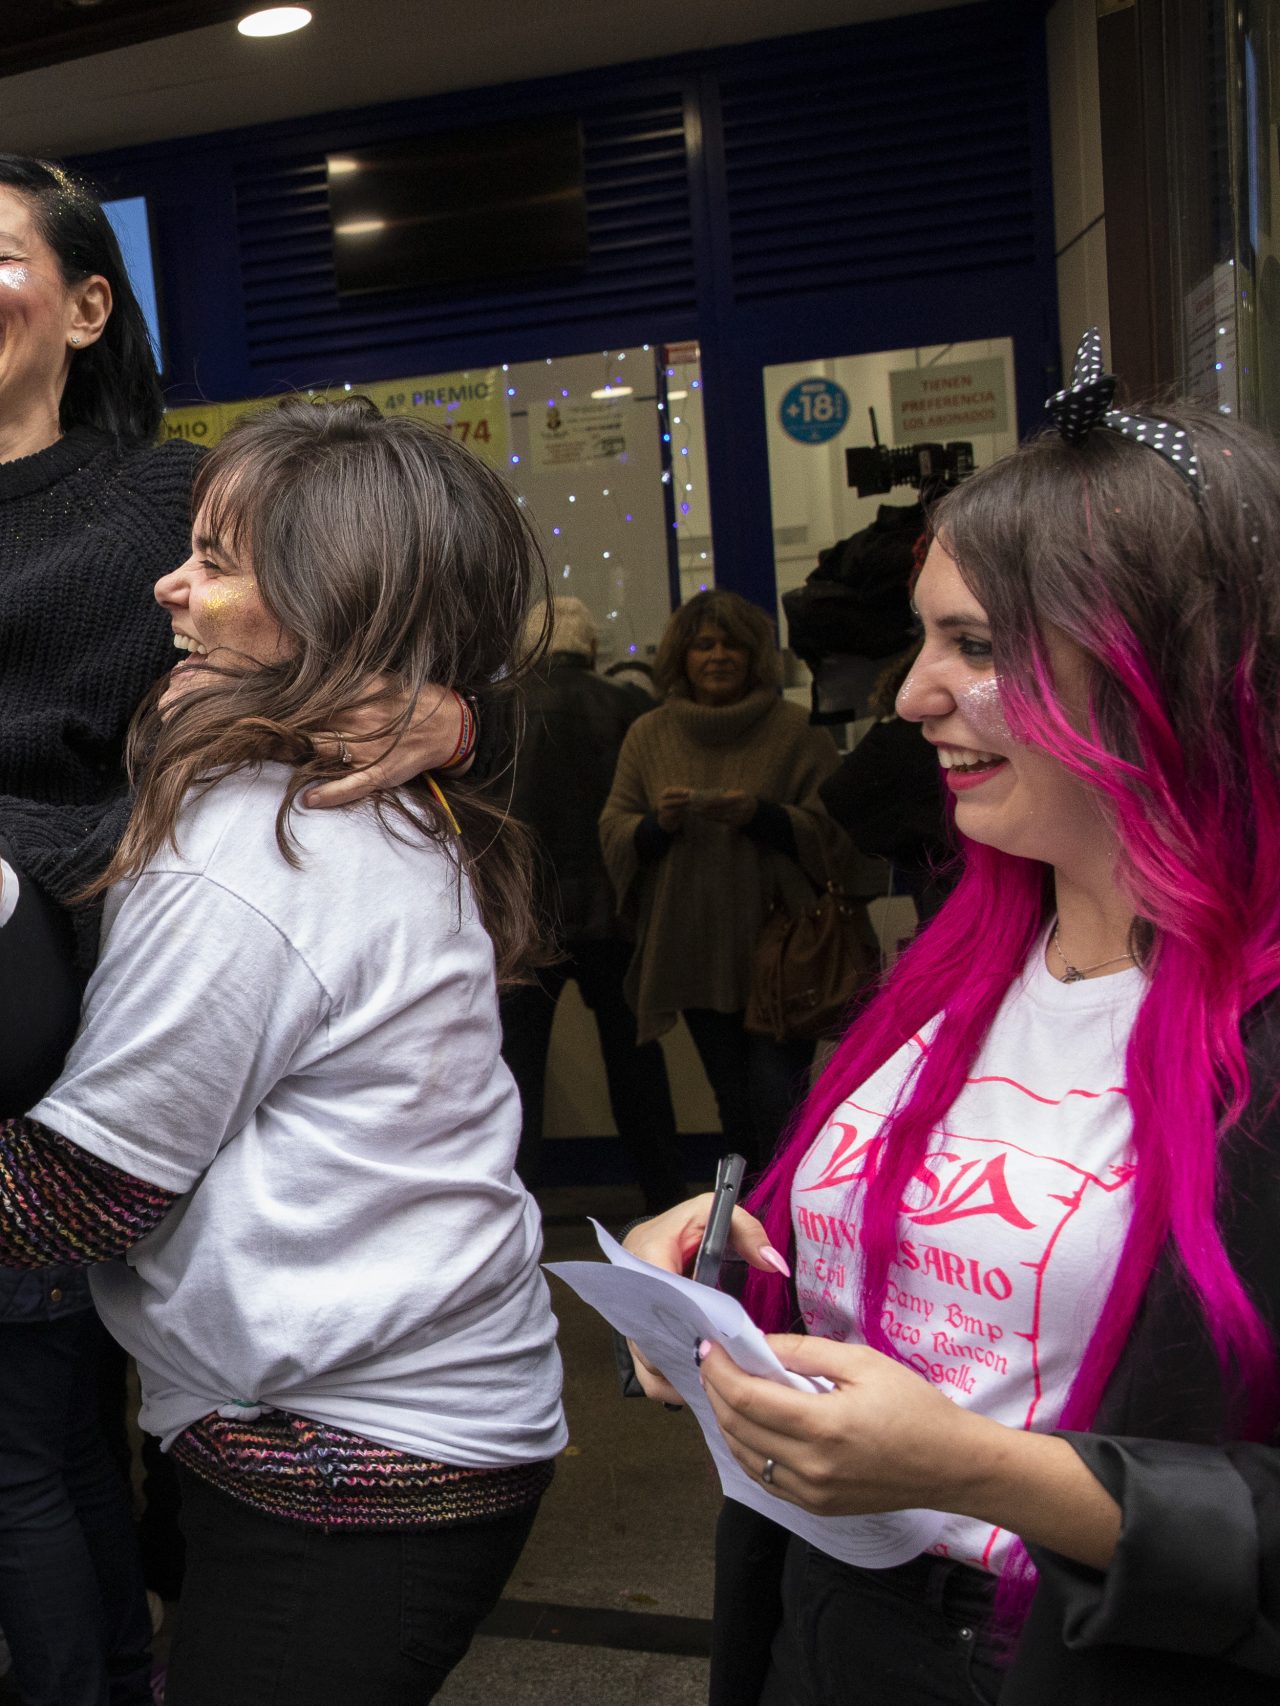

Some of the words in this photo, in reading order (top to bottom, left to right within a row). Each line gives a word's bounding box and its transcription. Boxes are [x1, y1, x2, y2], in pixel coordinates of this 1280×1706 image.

[410, 382, 489, 408] PREMIO
[921, 374, 971, 391] TIENEN
[787, 394, 833, 423] +18
[901, 390, 995, 413] PREFERENCIA
[162, 421, 208, 440] MIO
[796, 1205, 1013, 1301] ANIVSARIO
[944, 1302, 1004, 1344] Bmp
[931, 1331, 1008, 1376] Rincon
